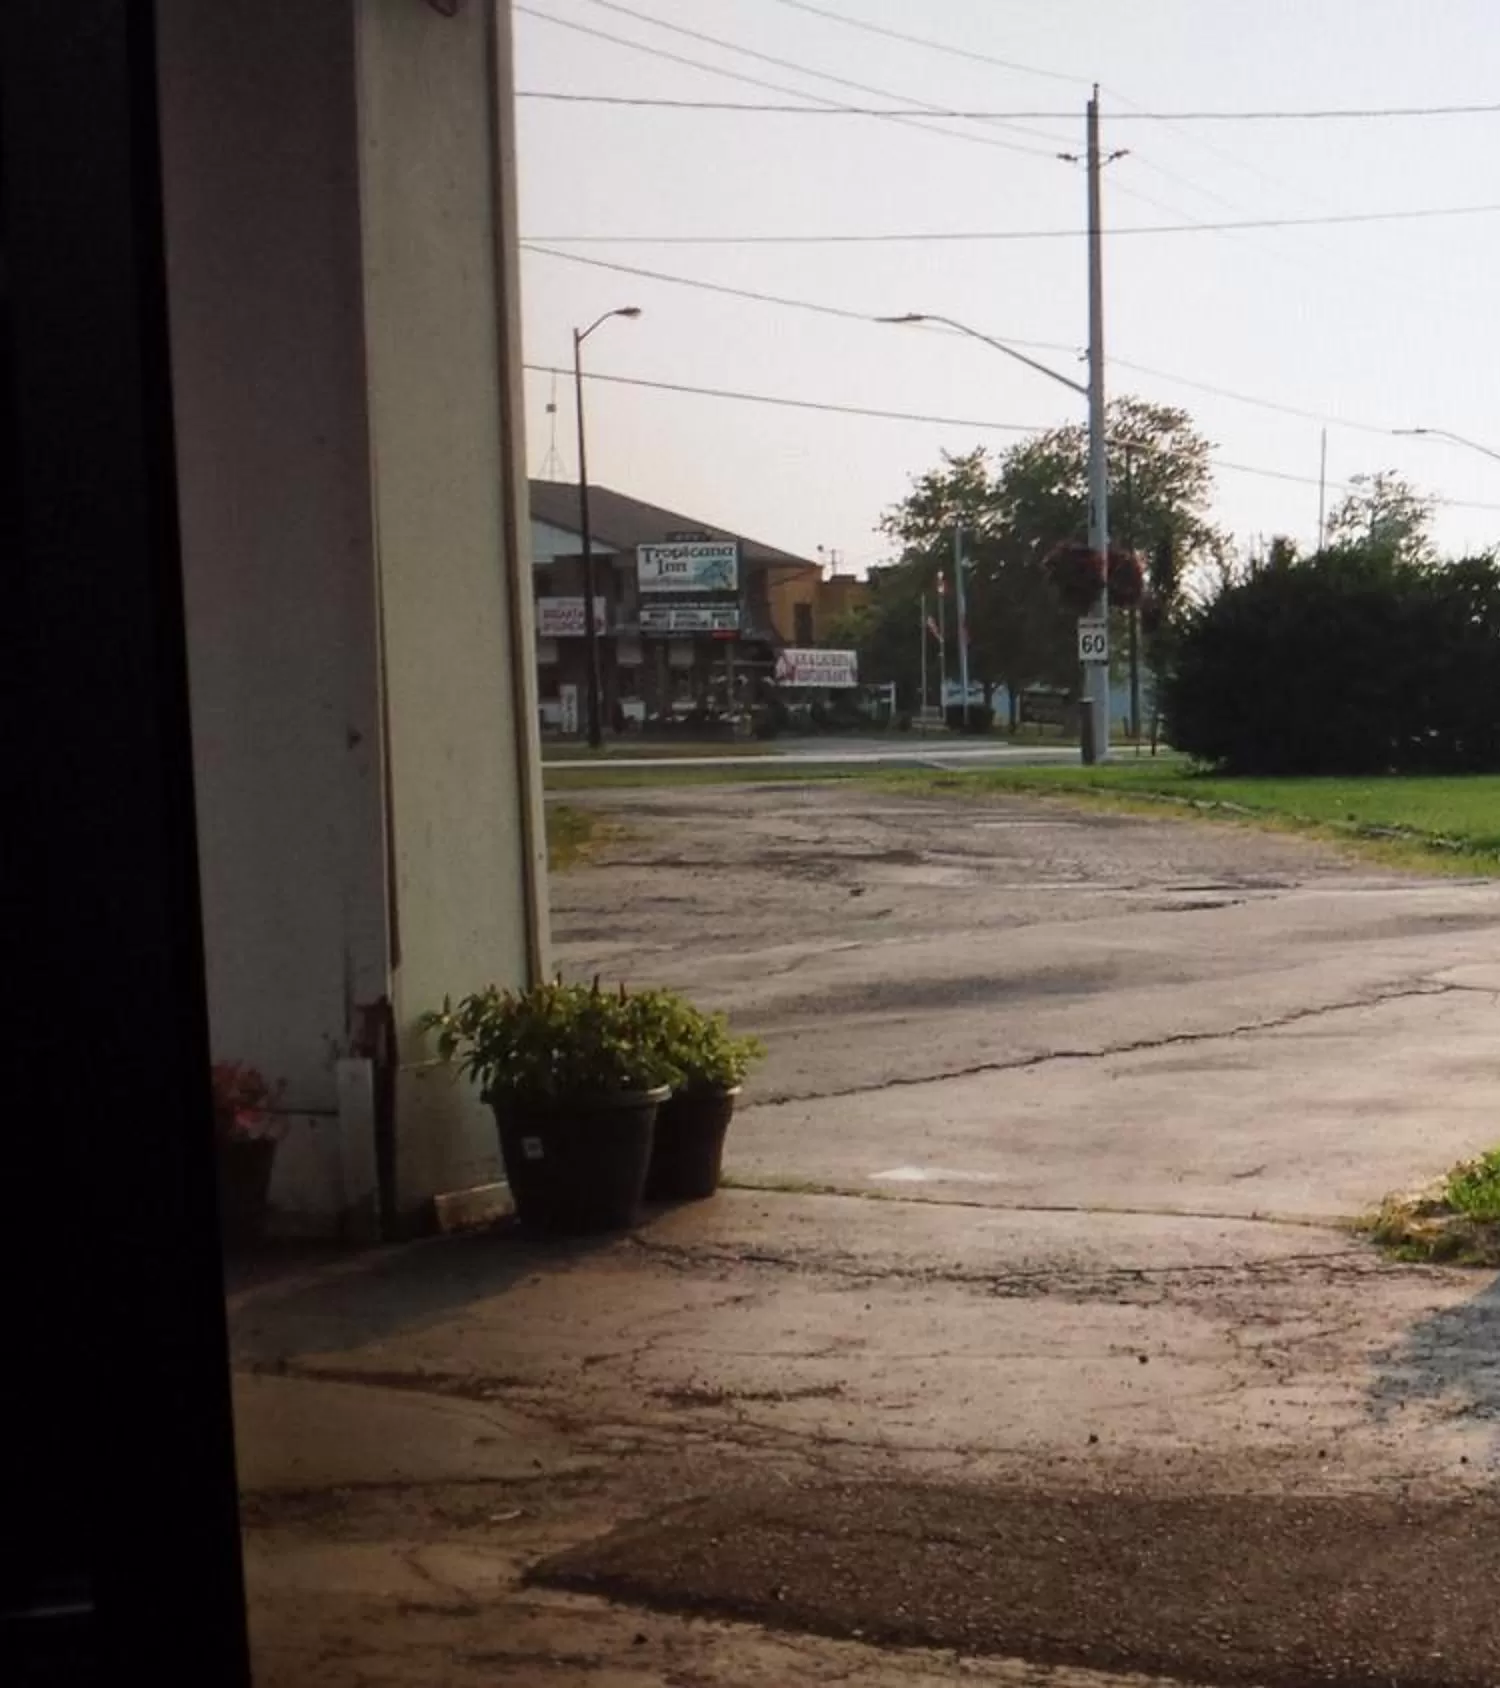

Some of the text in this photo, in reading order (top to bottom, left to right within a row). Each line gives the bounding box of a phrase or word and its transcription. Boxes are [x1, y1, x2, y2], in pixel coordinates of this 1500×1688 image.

[640, 547, 734, 564] Tropicana
[658, 559, 687, 574] Inn
[1082, 634, 1105, 654] 60
